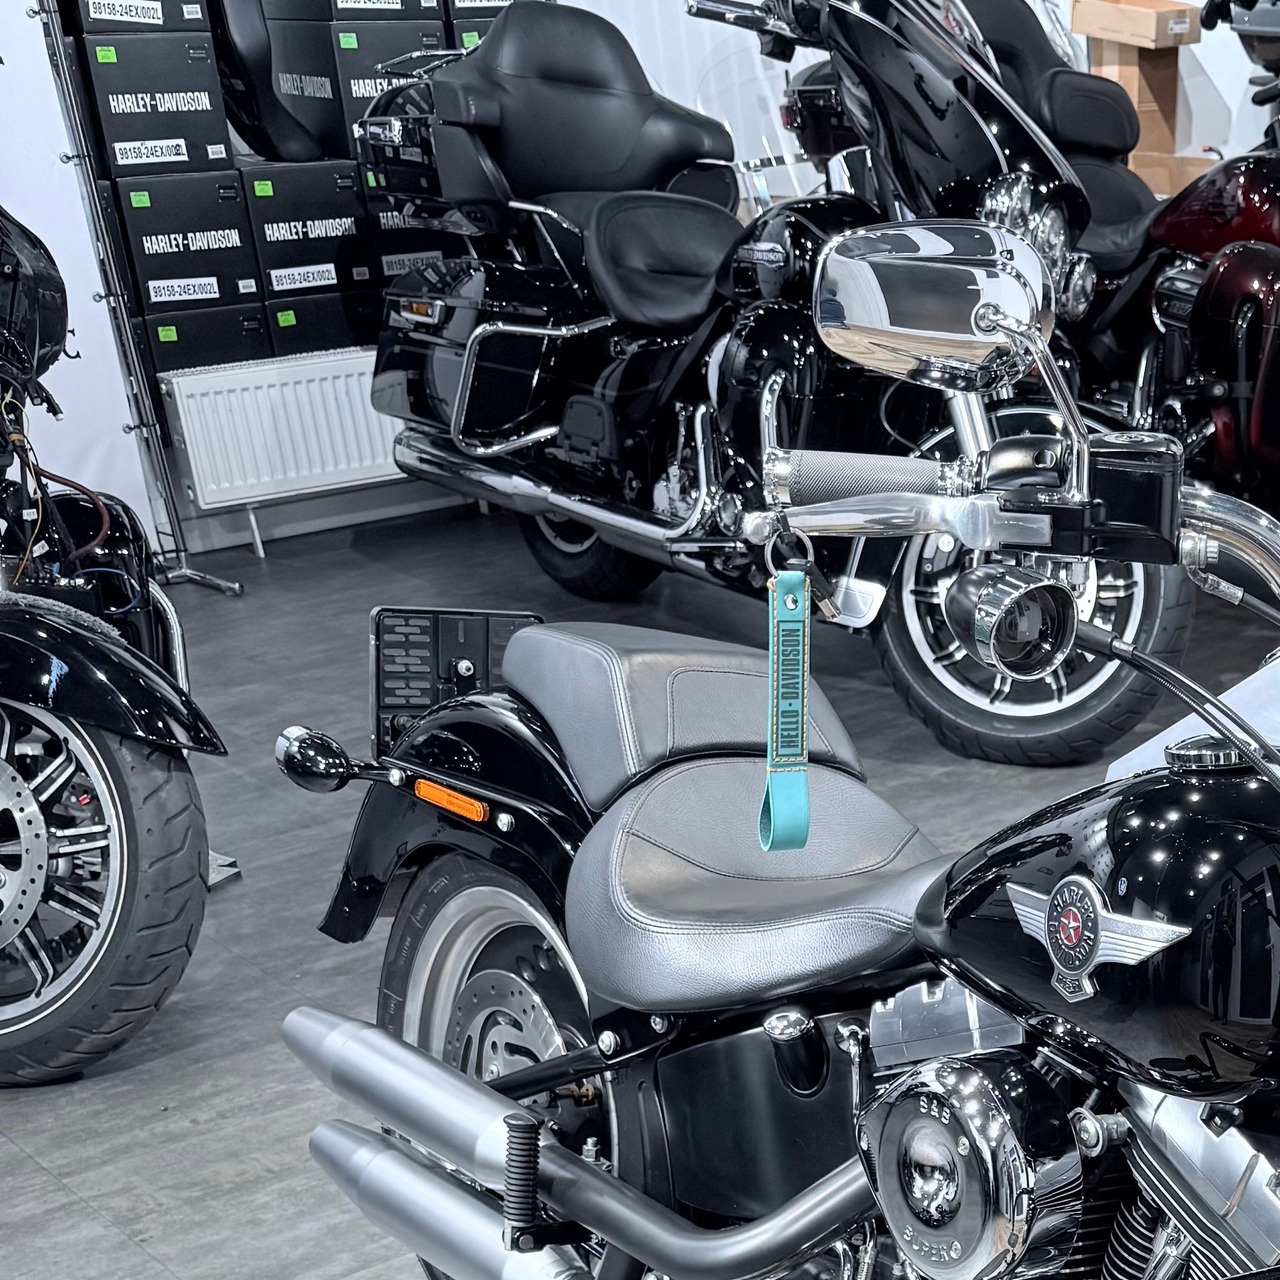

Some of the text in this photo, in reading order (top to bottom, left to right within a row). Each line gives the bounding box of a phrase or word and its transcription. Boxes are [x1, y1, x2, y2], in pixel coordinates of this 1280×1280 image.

[92, 1, 162, 20] 98158-24EX/002L
[108, 91, 213, 114] HARLEY-DAVIDSON
[142, 228, 243, 255] HARLEY-DAVIDSON
[263, 217, 357, 242] HARLEY-DAVIDSON
[152, 282, 217, 298] 98158-24EX/002L
[274, 269, 336, 287] 98158-24EX/002L
[780, 628, 801, 749] HELLO DAVIDSON
[1053, 886, 1095, 920] HARLEY
